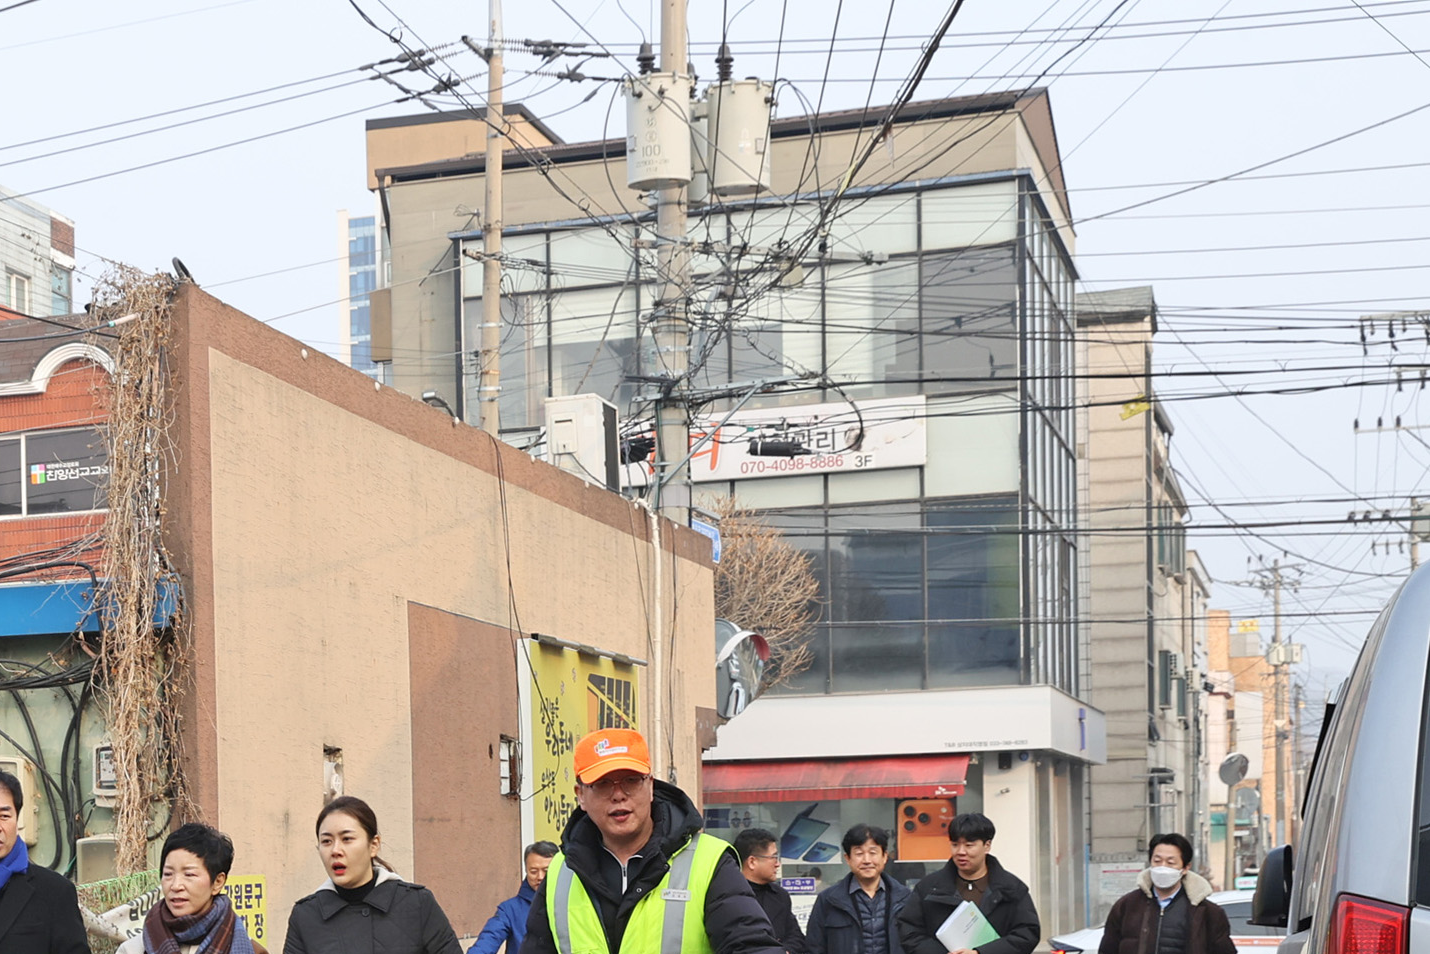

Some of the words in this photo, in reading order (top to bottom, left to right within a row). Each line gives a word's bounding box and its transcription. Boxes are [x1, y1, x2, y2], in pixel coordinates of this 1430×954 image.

[642, 144, 661, 158] 100
[740, 455, 844, 474] 070-4098-8886
[854, 455, 873, 468] 3F
